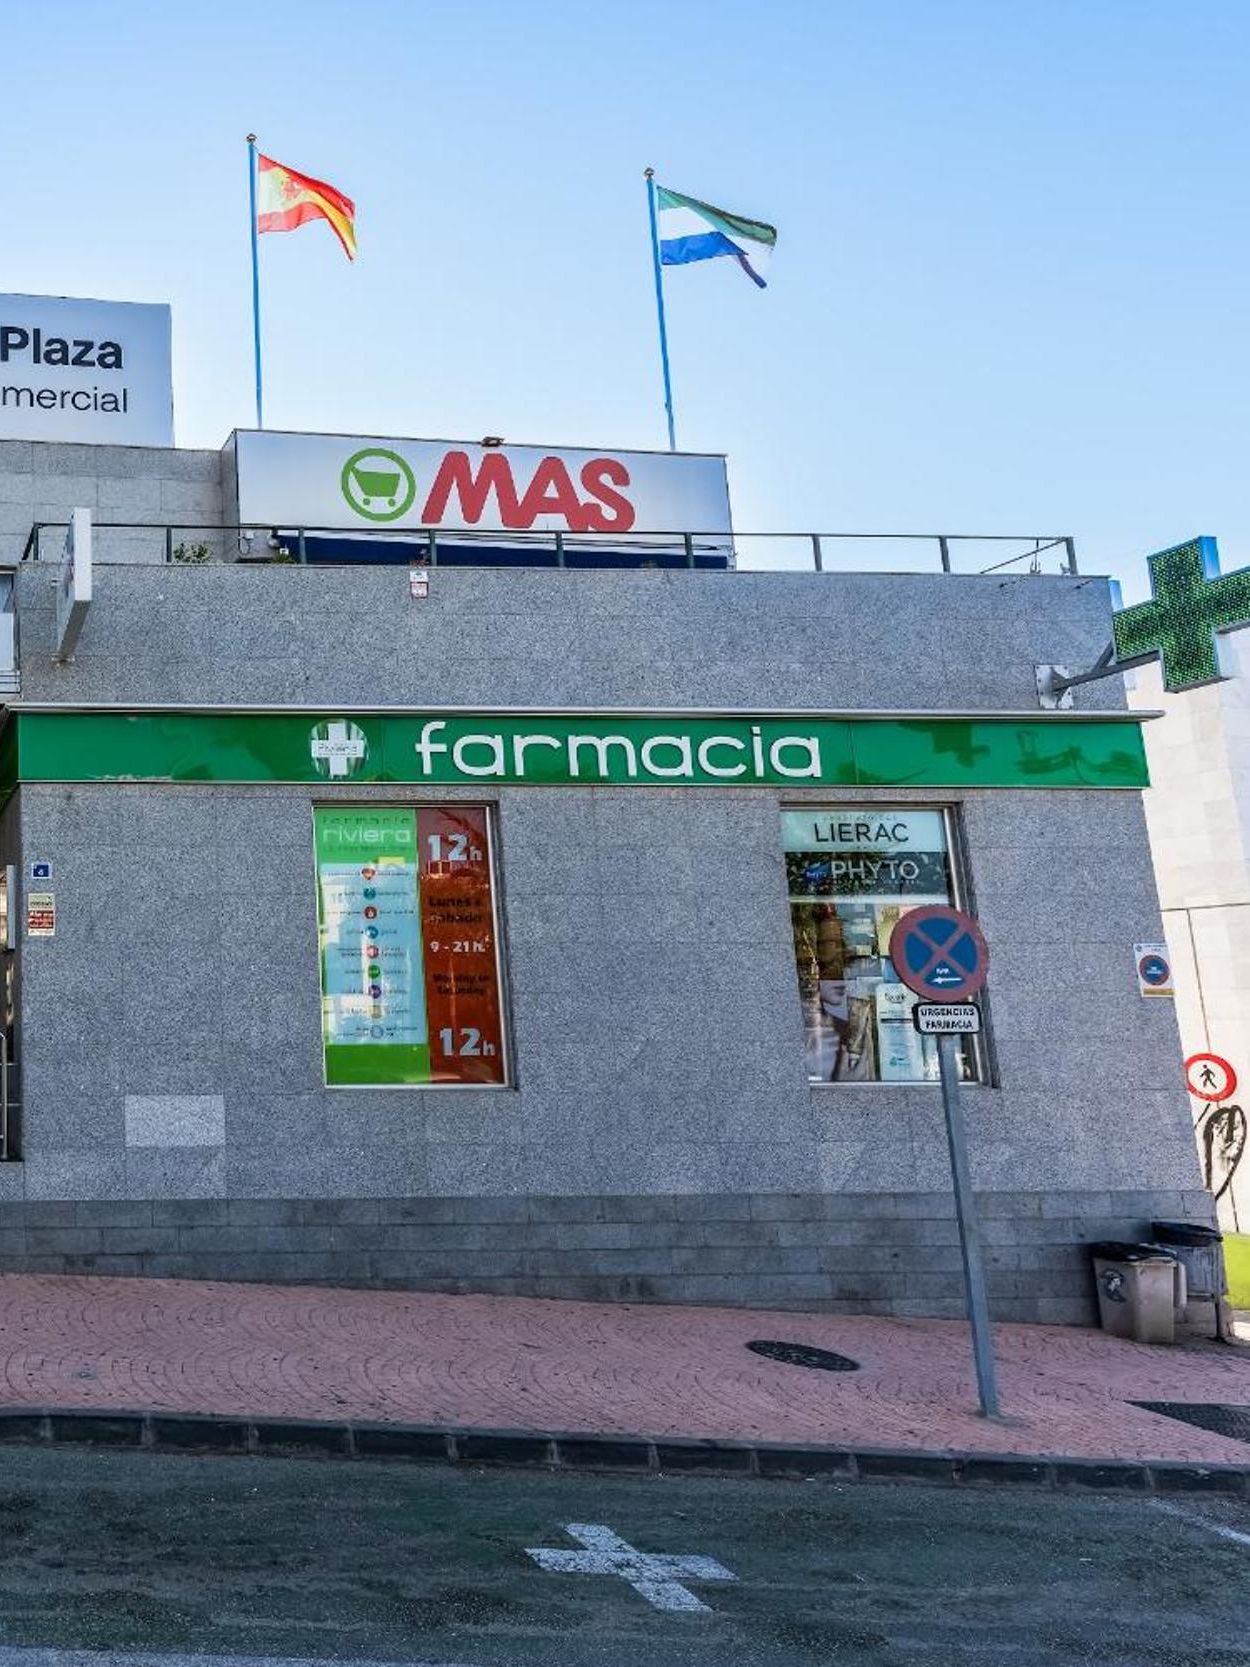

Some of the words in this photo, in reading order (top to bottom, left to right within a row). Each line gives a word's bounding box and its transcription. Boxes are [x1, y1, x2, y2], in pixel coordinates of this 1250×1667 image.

[0, 326, 124, 369] Plaza
[421, 450, 636, 533] MAS
[414, 721, 823, 778] farmacia
[323, 825, 411, 843] riviera
[814, 823, 910, 844] LIERAC
[831, 860, 920, 880] PHYTO
